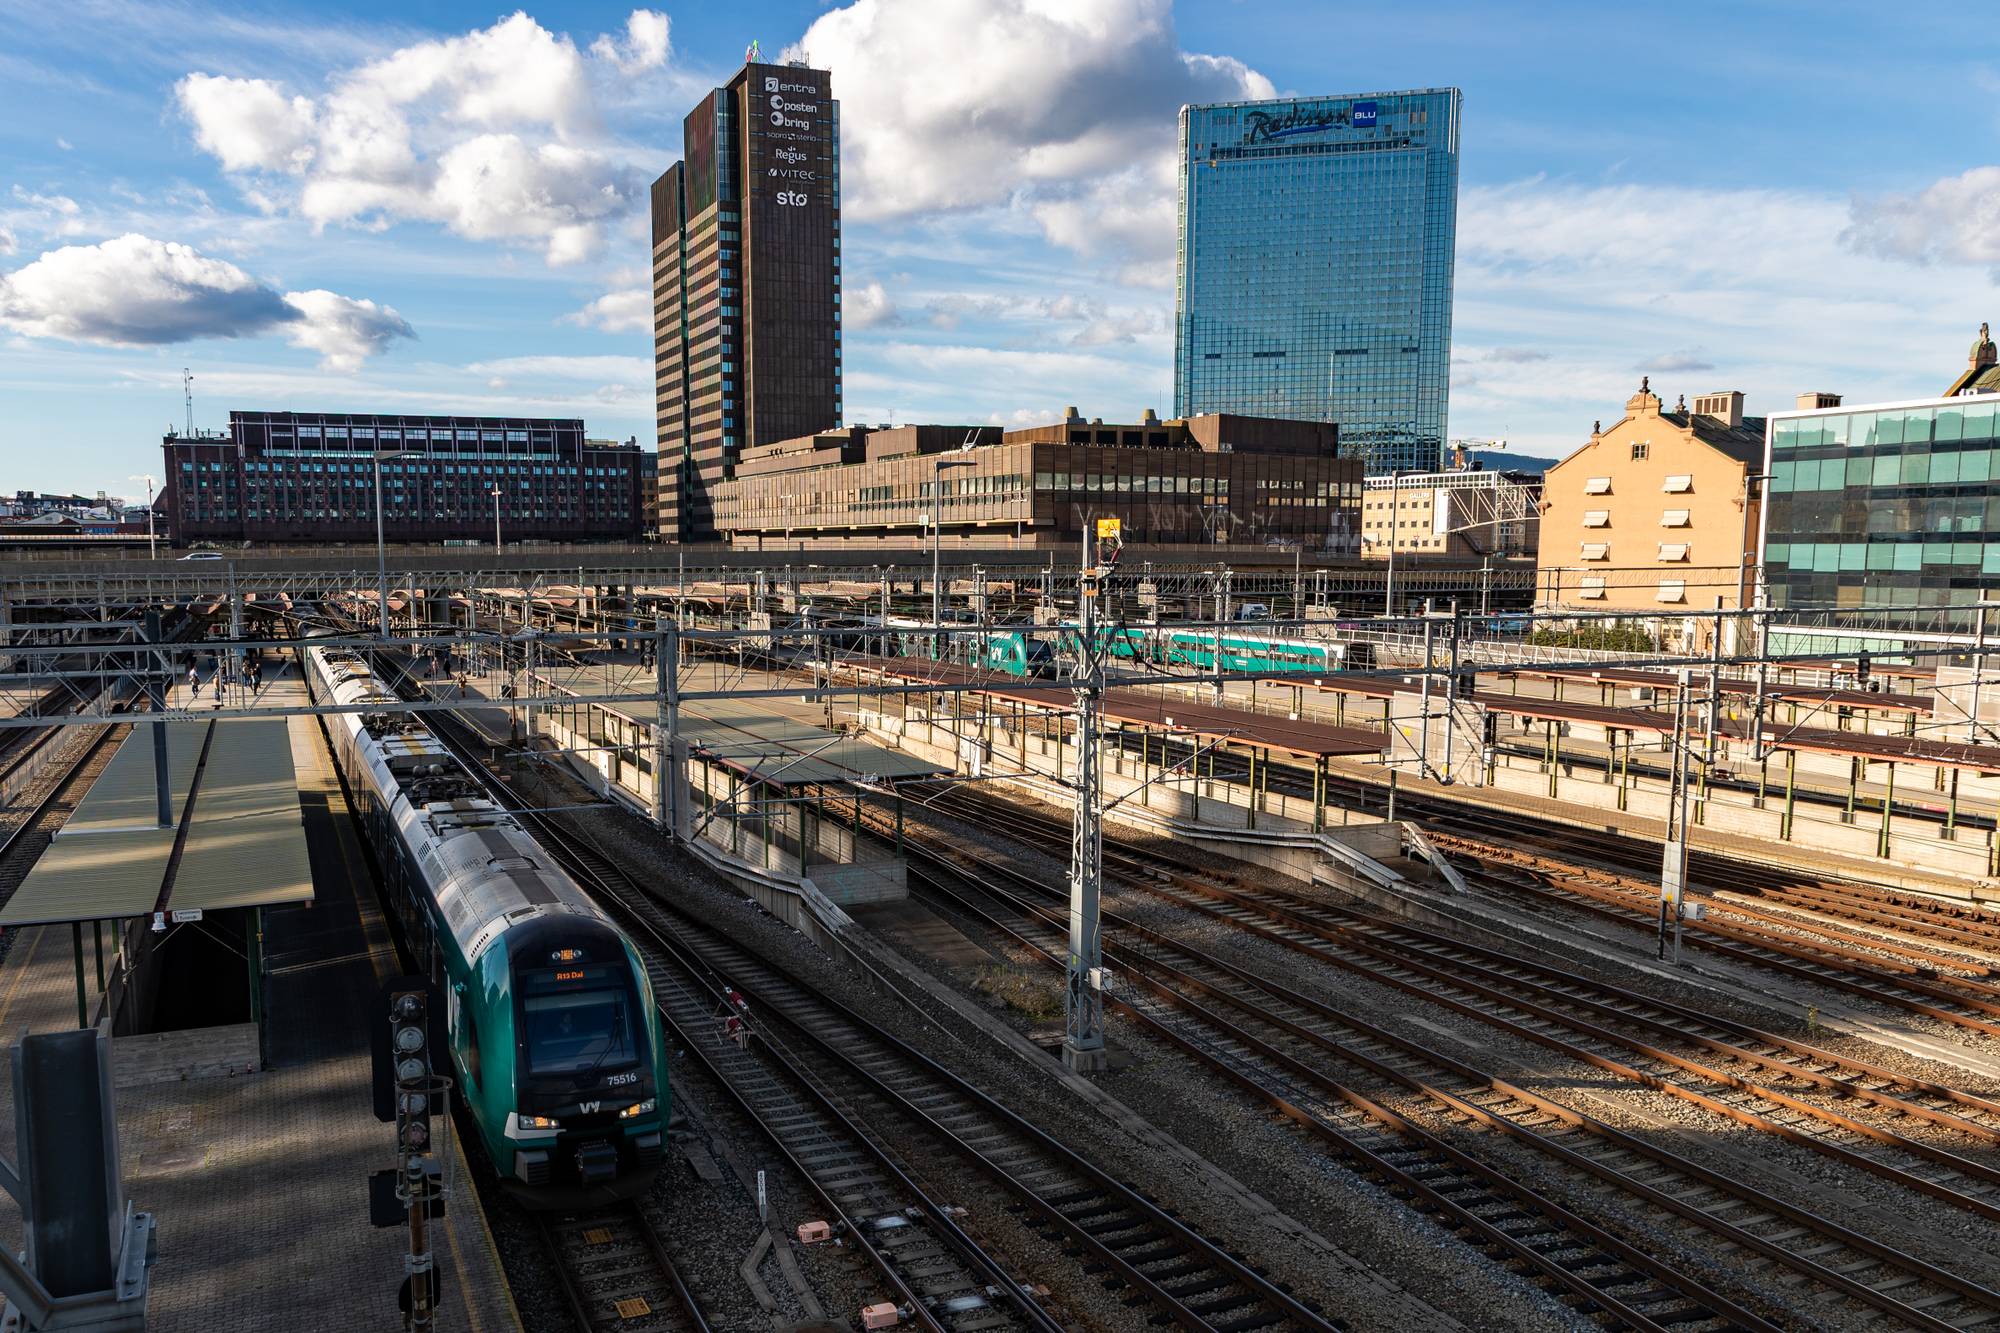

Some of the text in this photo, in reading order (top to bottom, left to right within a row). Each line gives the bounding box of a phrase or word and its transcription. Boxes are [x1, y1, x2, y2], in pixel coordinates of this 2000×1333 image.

[779, 82, 816, 94] entra
[784, 102, 817, 113] posten
[1354, 111, 1376, 120] BLU
[784, 116, 810, 131] bring
[775, 148, 807, 164] Regus
[607, 1072, 637, 1086] 75516
